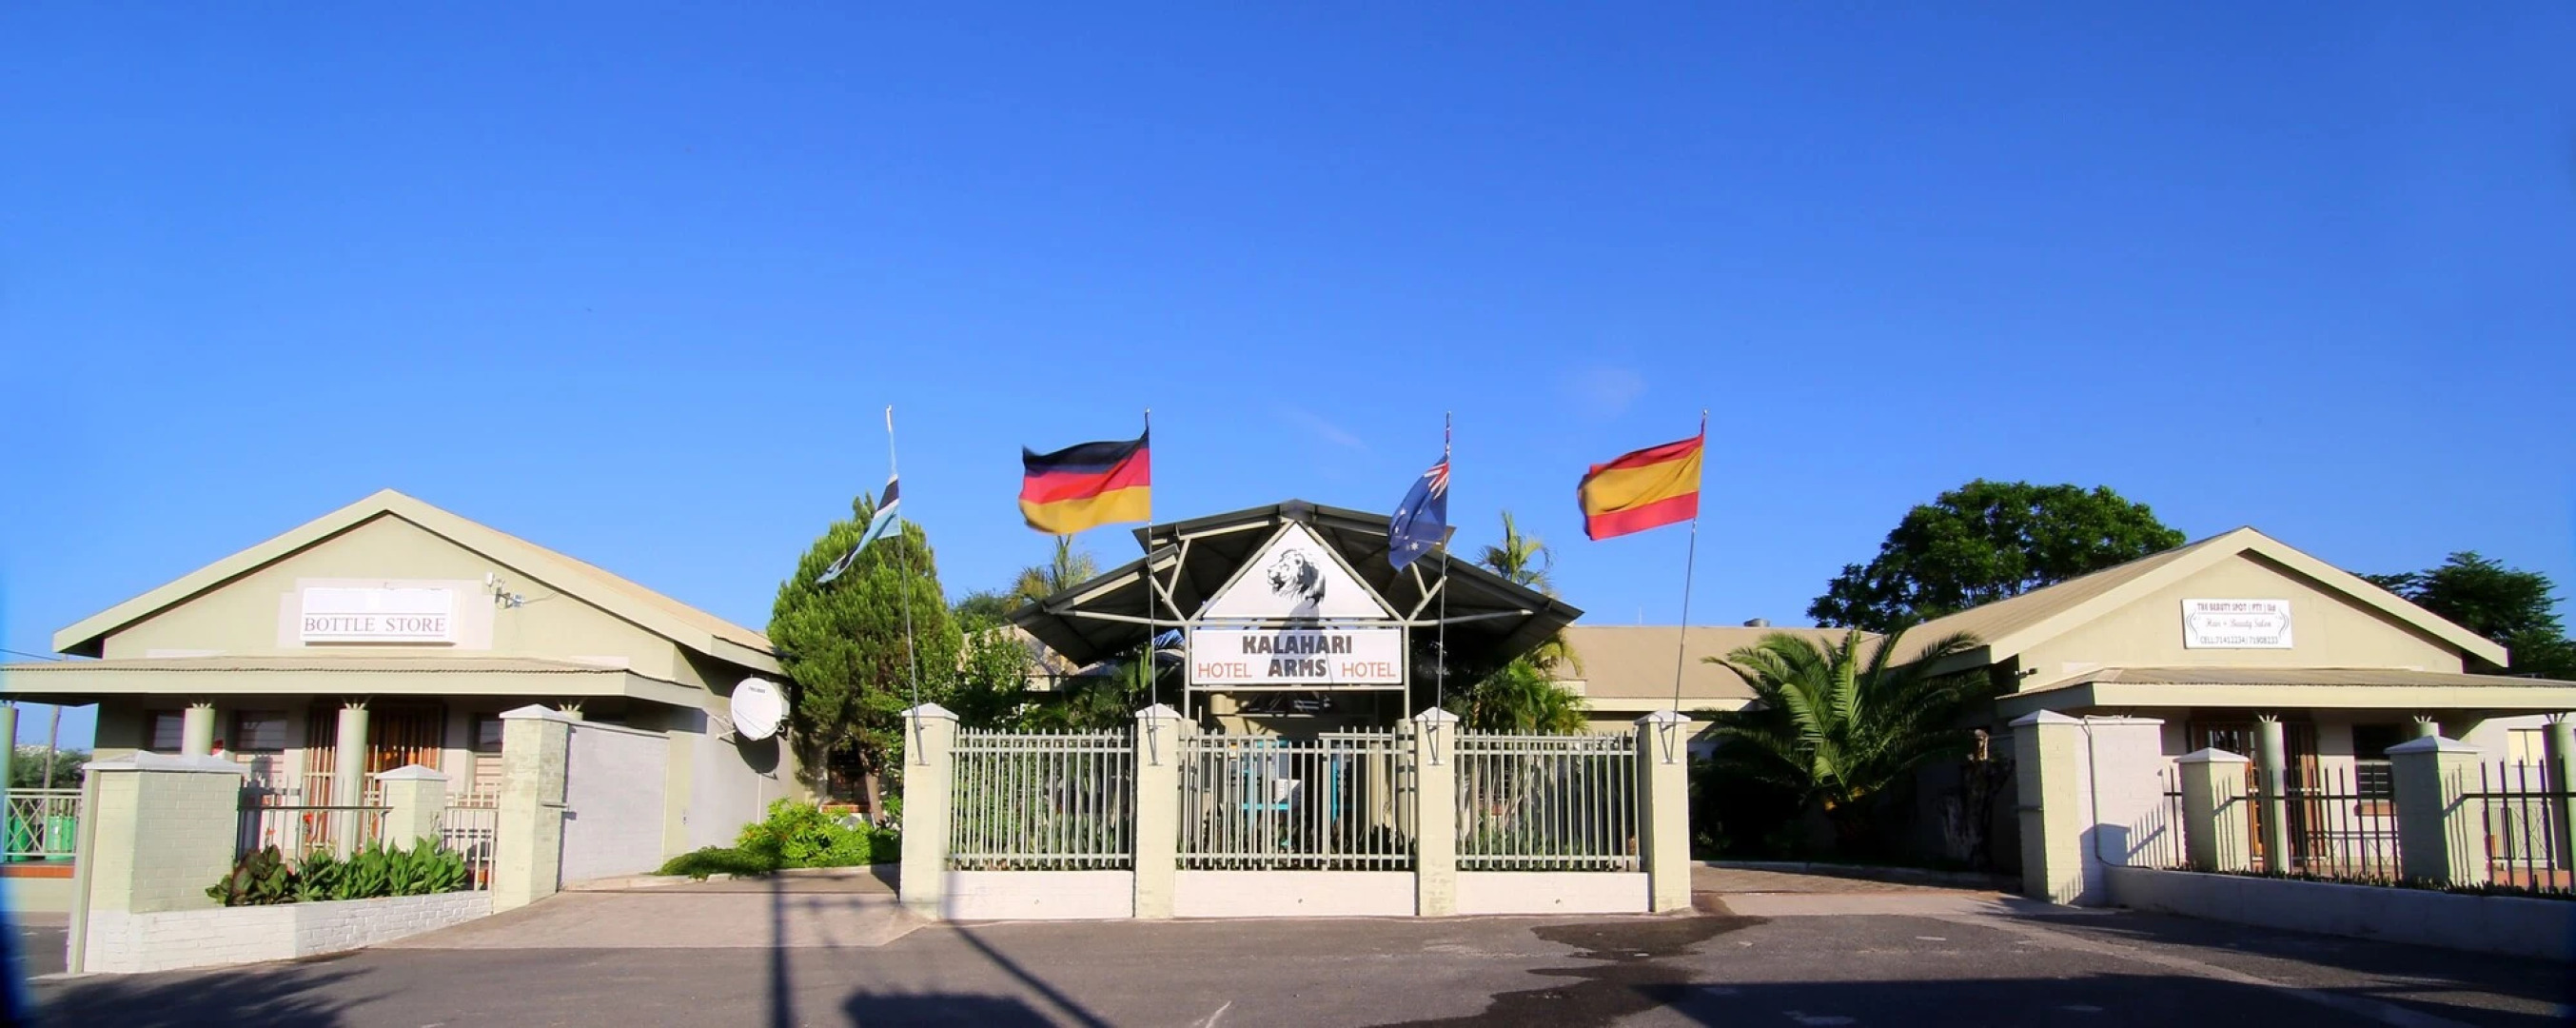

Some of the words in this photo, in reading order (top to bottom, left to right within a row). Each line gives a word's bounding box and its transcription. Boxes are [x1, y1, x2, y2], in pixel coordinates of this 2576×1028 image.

[2197, 603, 2208, 611] THE
[2210, 603, 2231, 612] BEAUTY
[2232, 603, 2247, 611] SPOT
[305, 617, 375, 632] BOTTLE
[385, 617, 445, 632] STORE
[2230, 618, 2252, 630] Beauty
[2253, 618, 2271, 627] Salon
[1242, 636, 1352, 654] KALAHARI
[1197, 662, 1252, 678] HOTEL
[1268, 659, 1327, 678] ARMS
[1341, 662, 1396, 678] HOTEL
